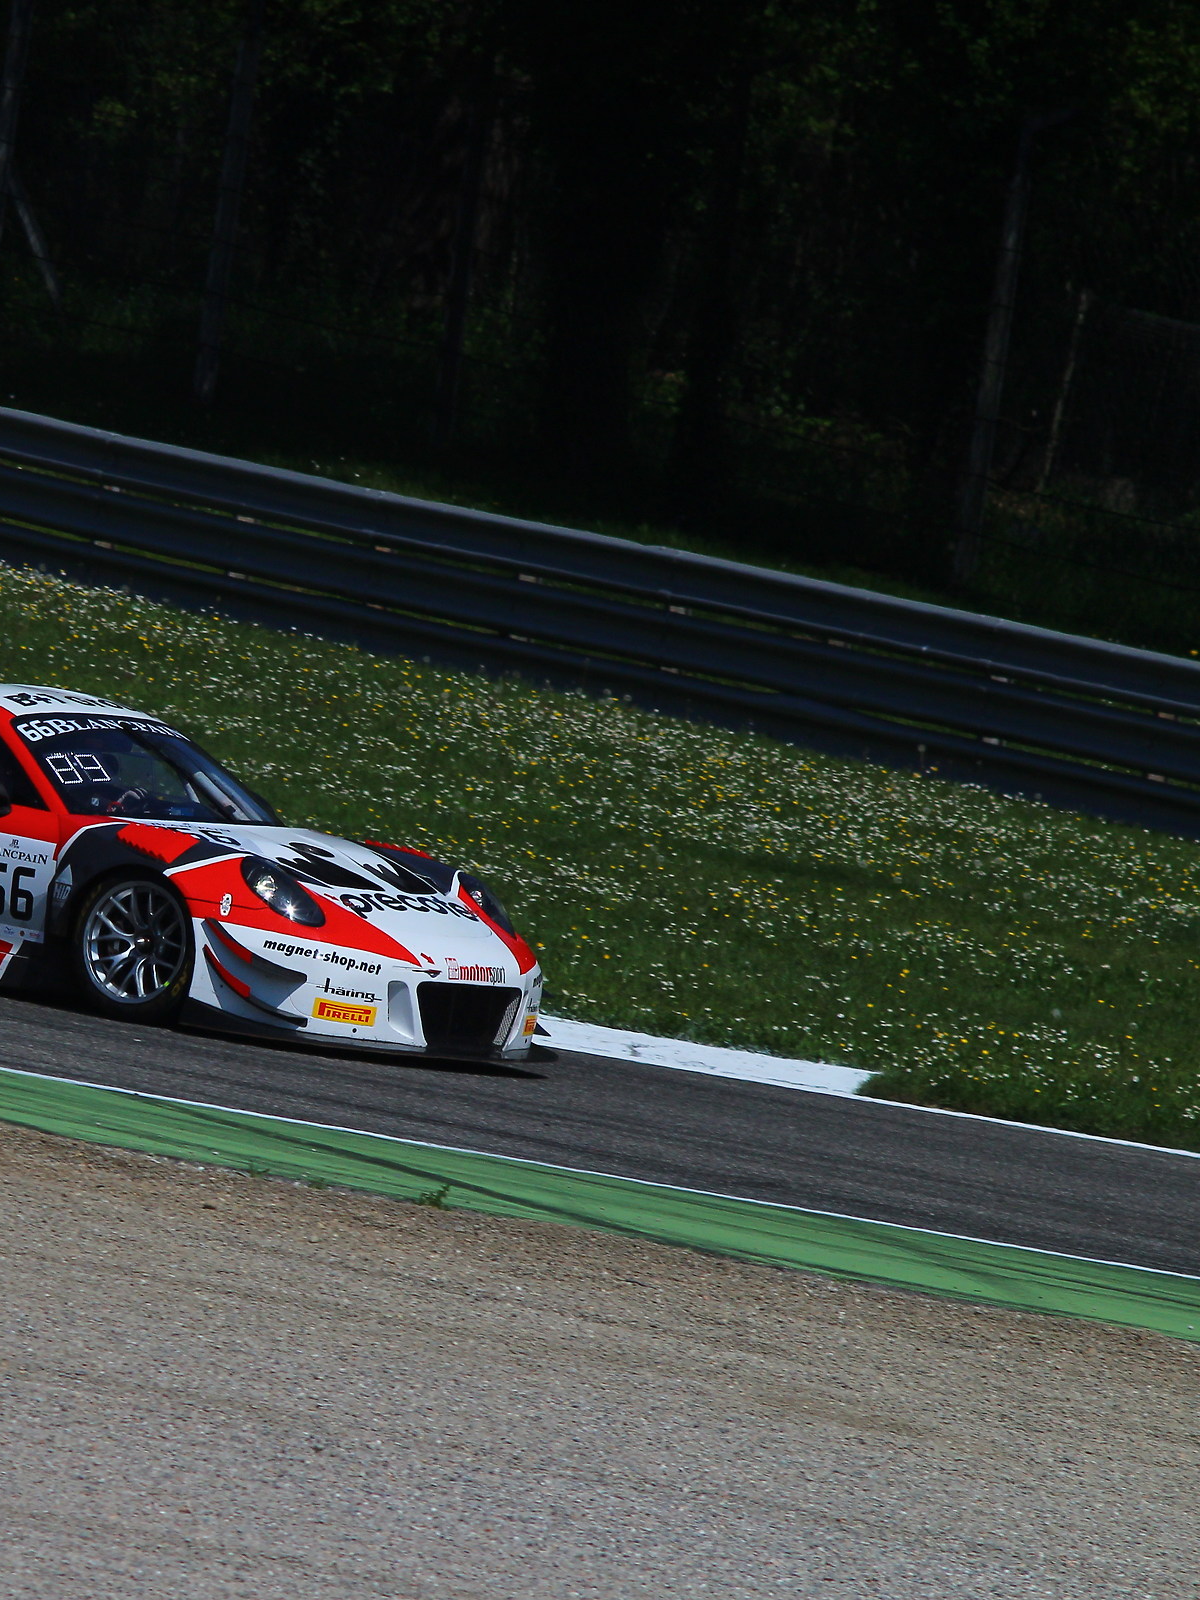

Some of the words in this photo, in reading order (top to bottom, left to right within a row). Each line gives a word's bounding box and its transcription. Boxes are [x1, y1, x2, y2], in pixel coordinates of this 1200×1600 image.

[340, 893, 479, 922] precote
[262, 939, 382, 975] magnet-shop.net
[317, 1001, 372, 1023] PIRELLI
